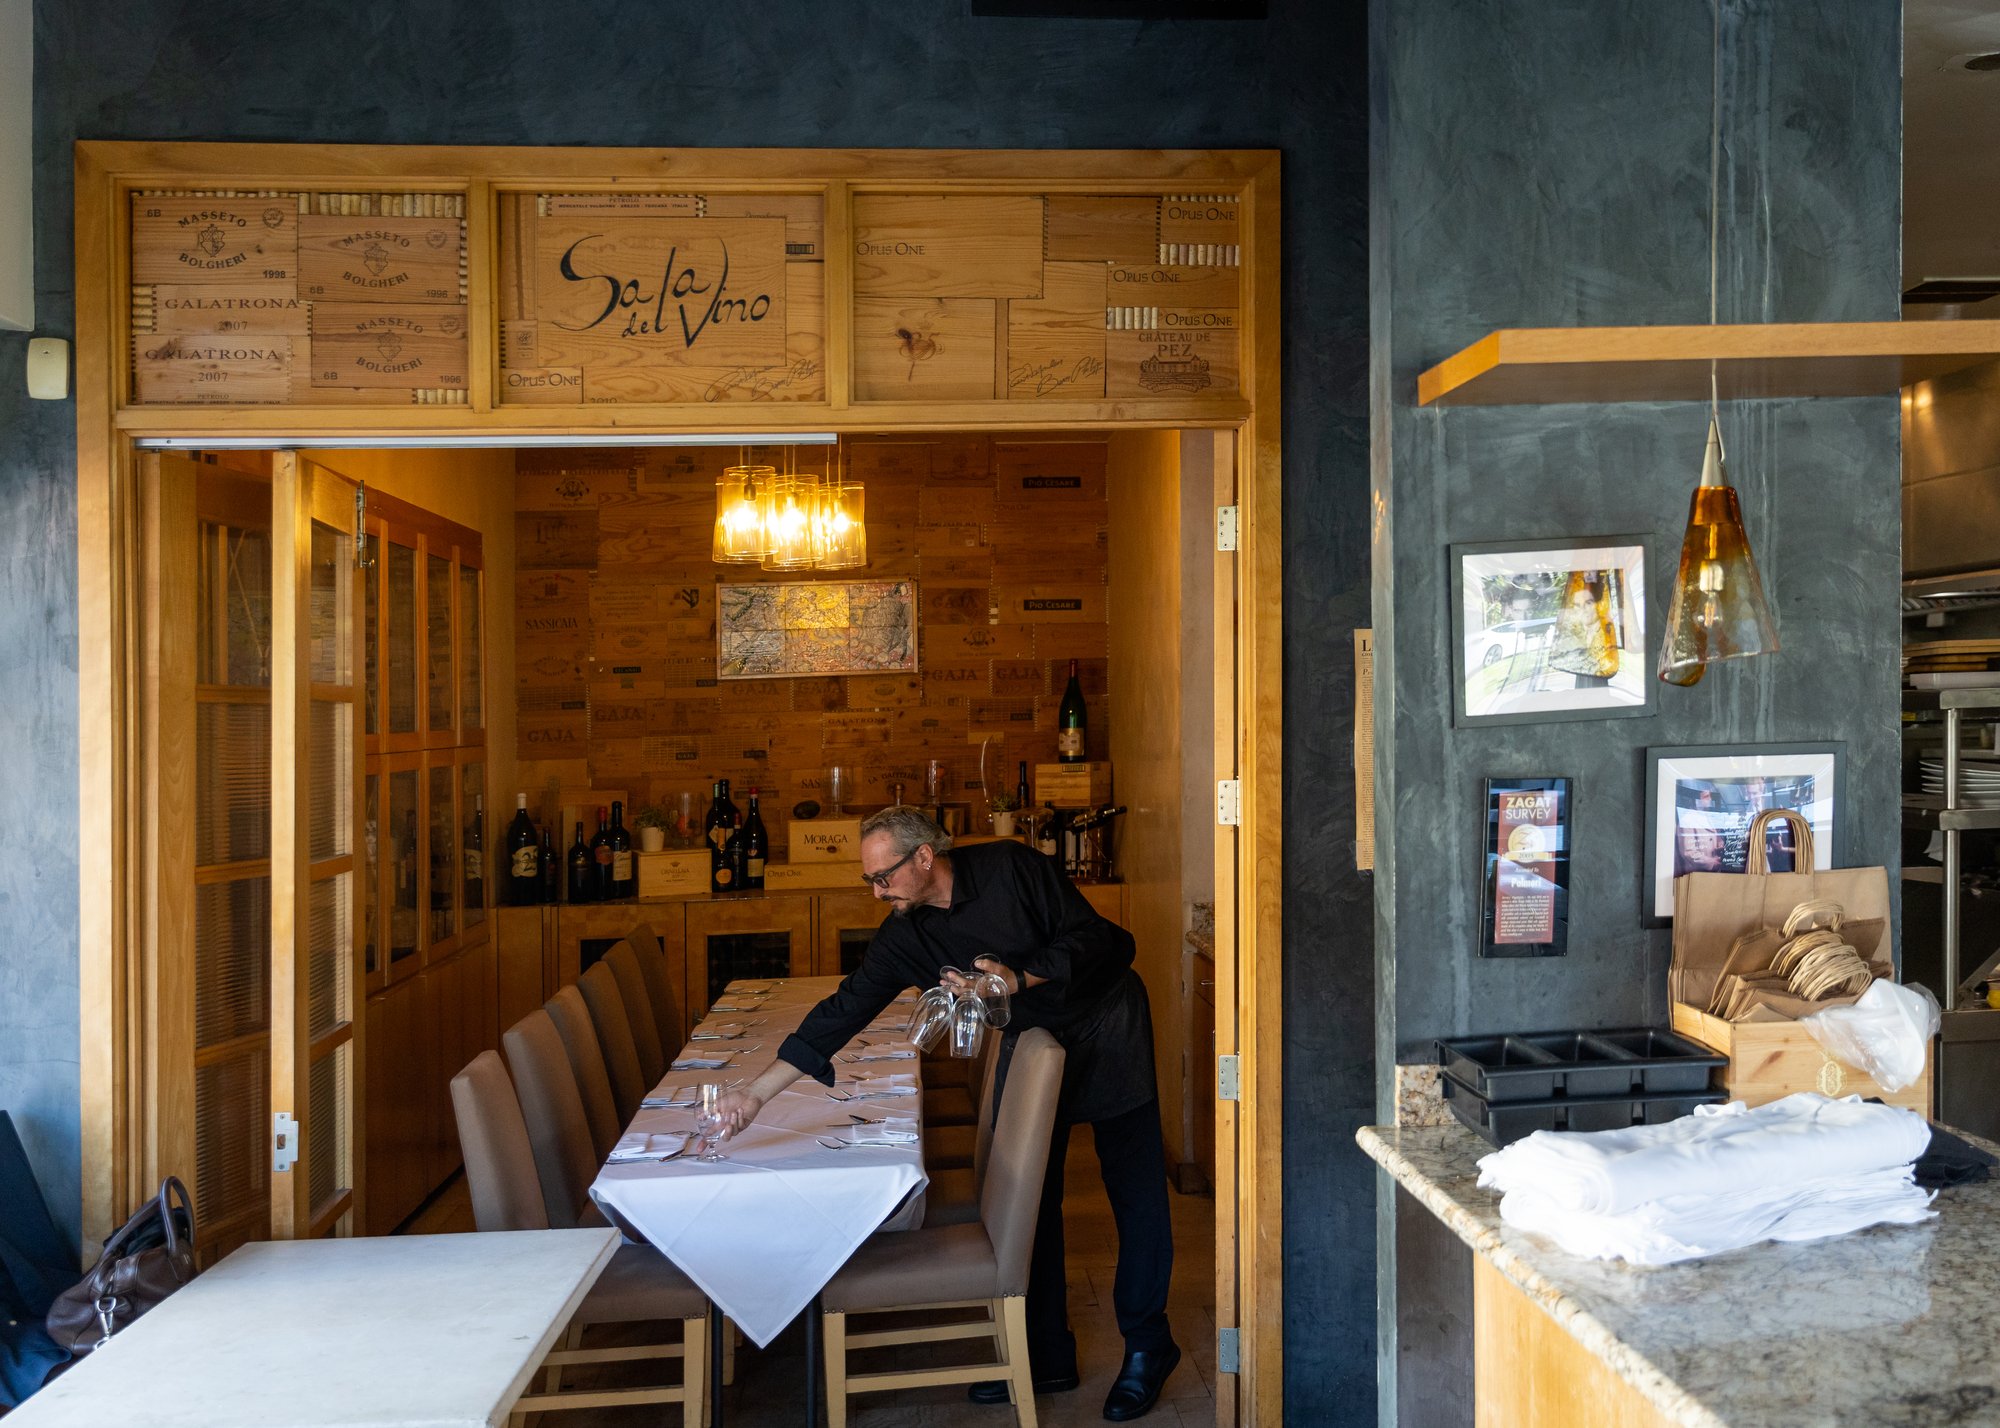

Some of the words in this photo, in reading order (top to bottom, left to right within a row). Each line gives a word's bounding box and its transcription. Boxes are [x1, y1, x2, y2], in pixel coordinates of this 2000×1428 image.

[145, 208, 162, 218] 6B
[177, 210, 247, 228] MASSETO
[343, 230, 411, 248] MASSETO
[178, 251, 248, 270] BOLGHERI
[342, 271, 410, 288] BOLGHERI
[552, 234, 712, 333] Sala
[309, 285, 325, 295] 6B
[679, 235, 771, 349] Vino
[164, 298, 299, 310] GALATRONA
[217, 320, 248, 331] 2007
[355, 317, 424, 334] MASSETO
[1138, 331, 1193, 343] CHÂTEAU
[1196, 332, 1211, 342] DE
[145, 349, 279, 360] GALATRONA
[1157, 343, 1192, 357] PEZ
[355, 356, 423, 374] BOLGHERI
[197, 371, 229, 382] 2007
[323, 371, 339, 381] 6B
[1029, 600, 1043, 609] PIO
[1046, 600, 1077, 609] CESARE
[525, 617, 578, 630] SASSICAIA
[931, 668, 978, 681] GAJA
[995, 667, 1042, 681] GAJA
[732, 682, 779, 696] GAJA
[593, 708, 643, 722] GAJA
[527, 728, 577, 743] GAJA
[1506, 796, 1552, 809] ZAGAT
[1505, 808, 1551, 819] SURVEY
[803, 833, 849, 845] MORAGA
